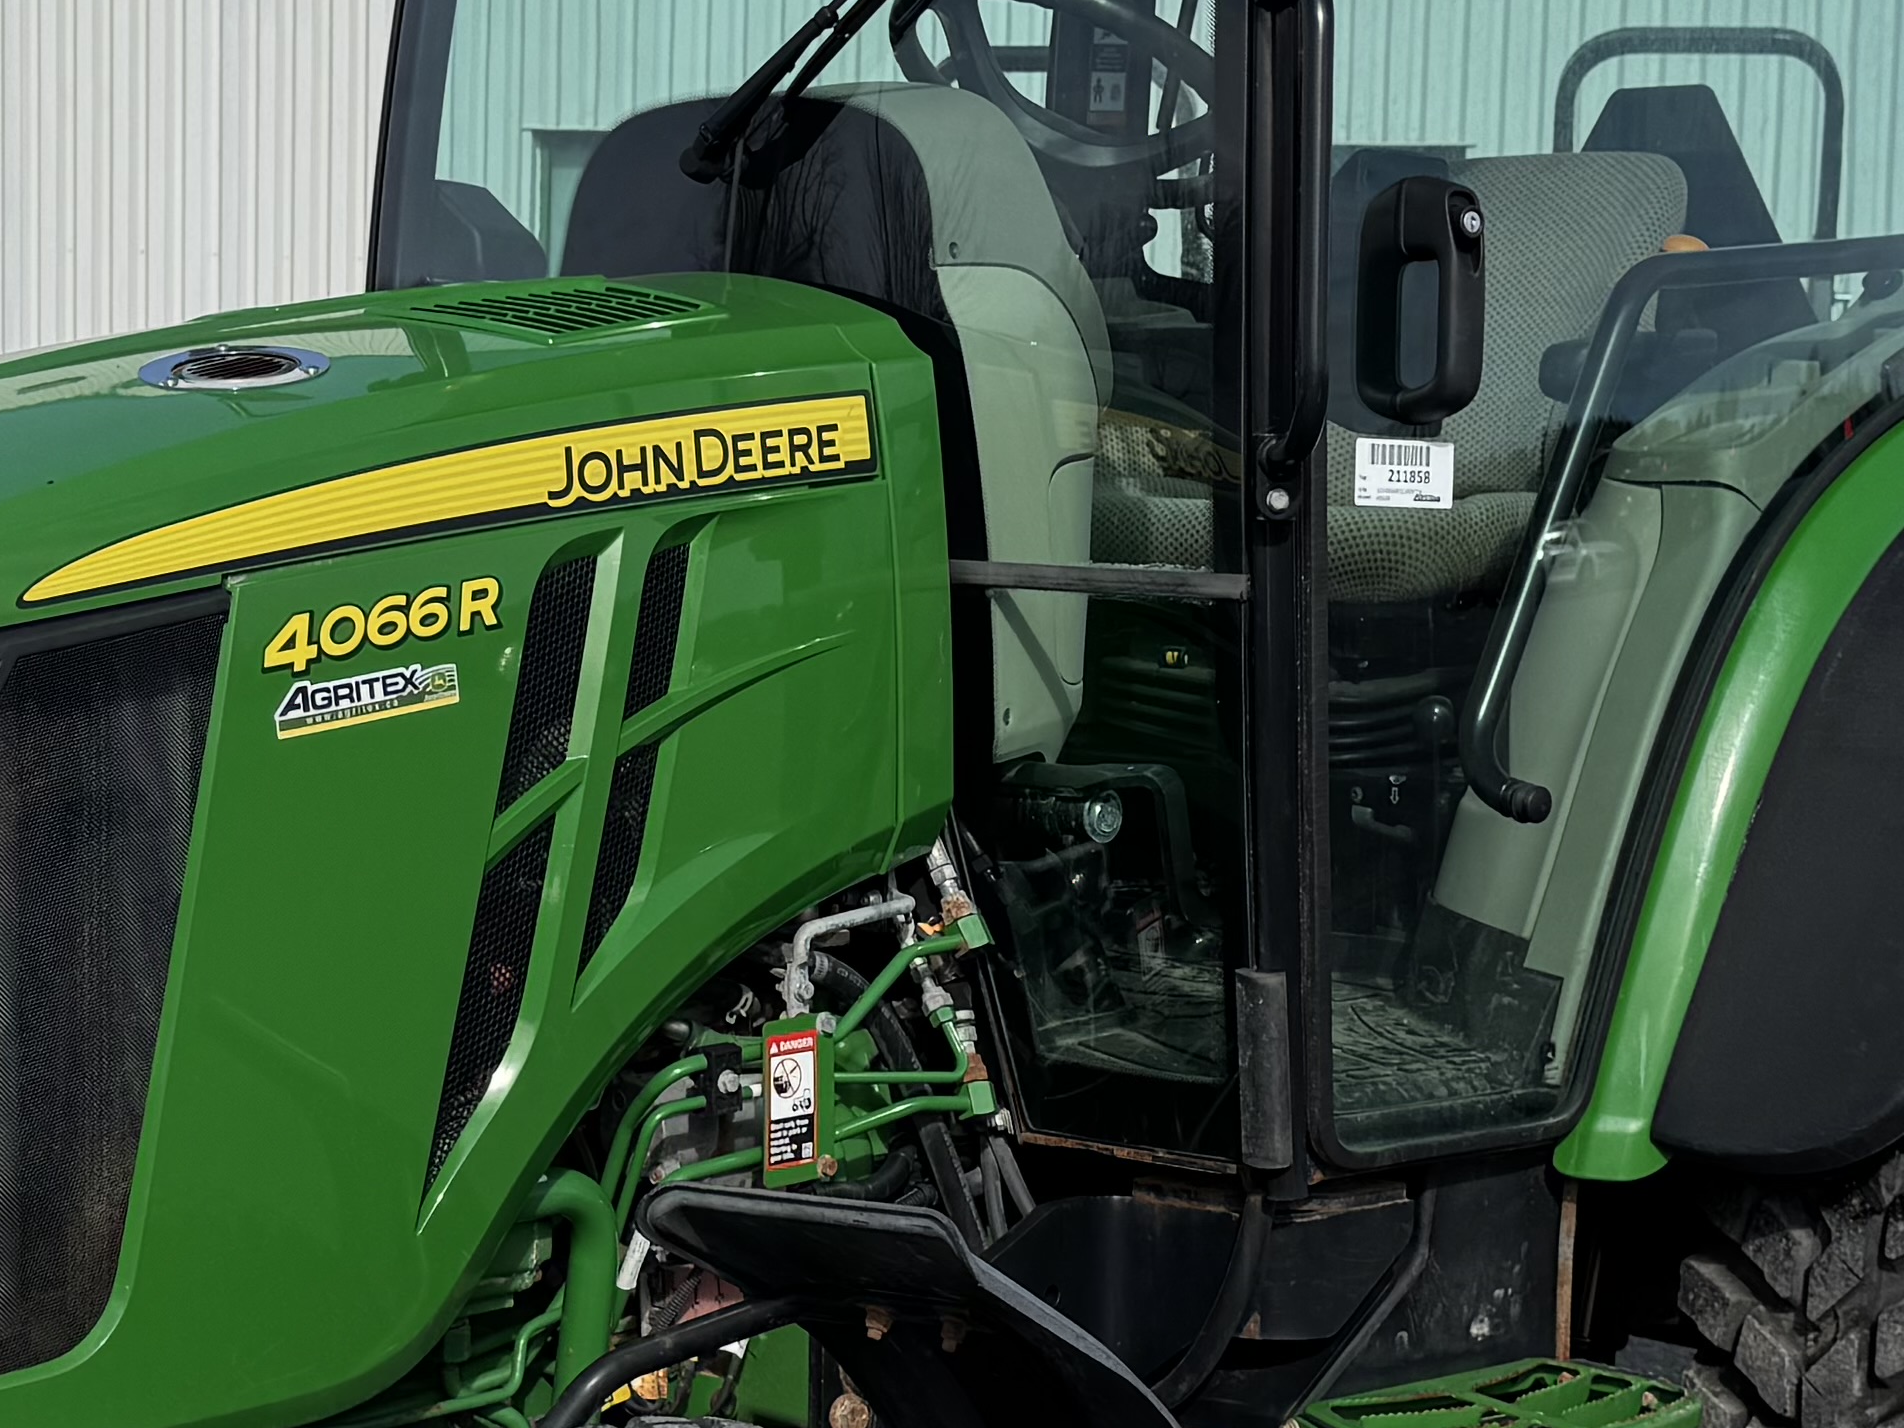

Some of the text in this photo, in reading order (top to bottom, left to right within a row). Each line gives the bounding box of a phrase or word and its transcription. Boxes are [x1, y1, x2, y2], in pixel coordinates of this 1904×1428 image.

[547, 423, 841, 500] JOHN DEERE
[1387, 469, 1431, 484] 211858
[279, 669, 421, 717] AGRITEX
